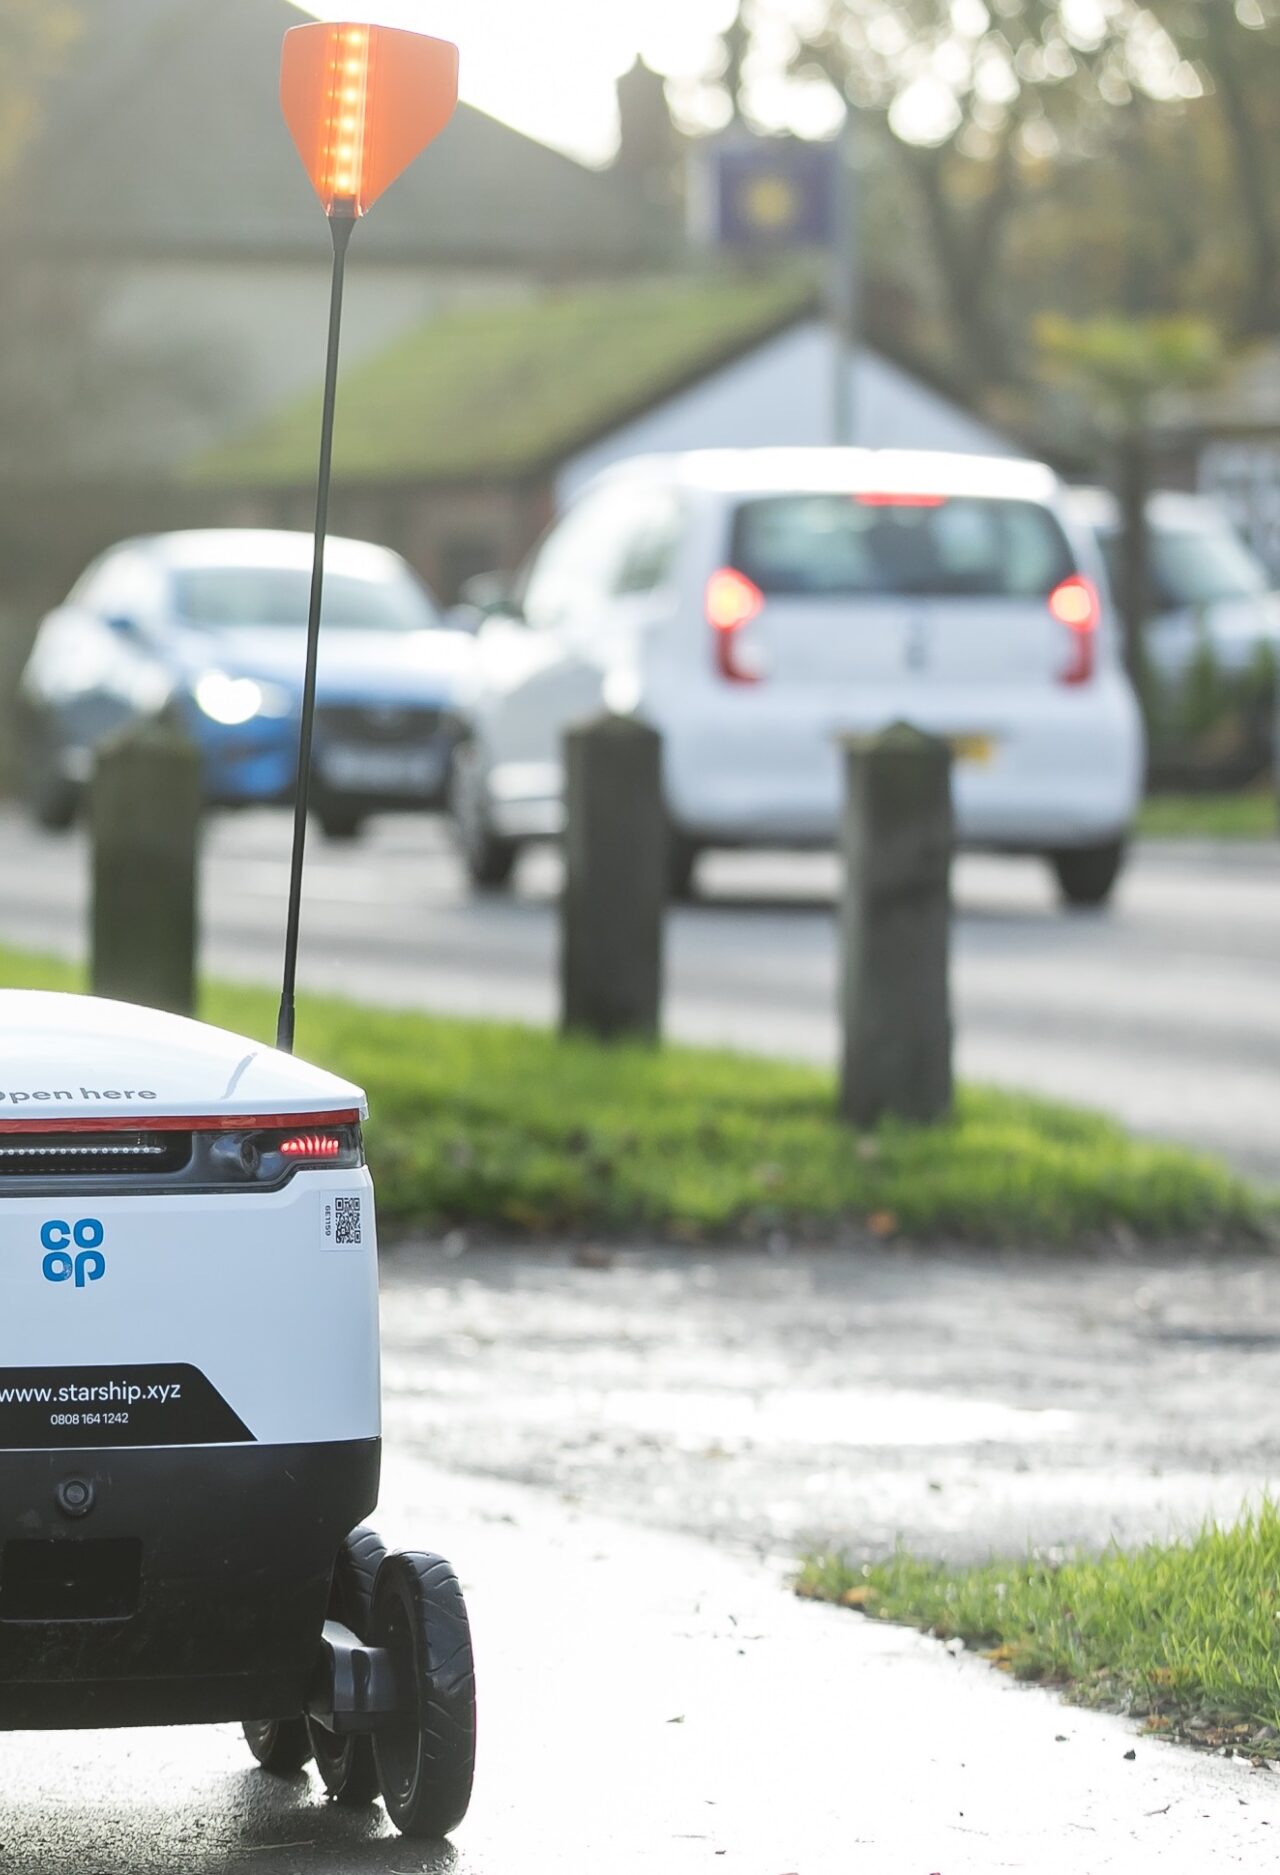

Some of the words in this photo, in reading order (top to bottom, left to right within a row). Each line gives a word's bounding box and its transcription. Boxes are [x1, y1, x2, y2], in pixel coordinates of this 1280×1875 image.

[79, 1087, 158, 1100] here
[50, 1414, 80, 1426] 0808
[81, 1413, 101, 1425] 164
[102, 1412, 129, 1425] 1242
